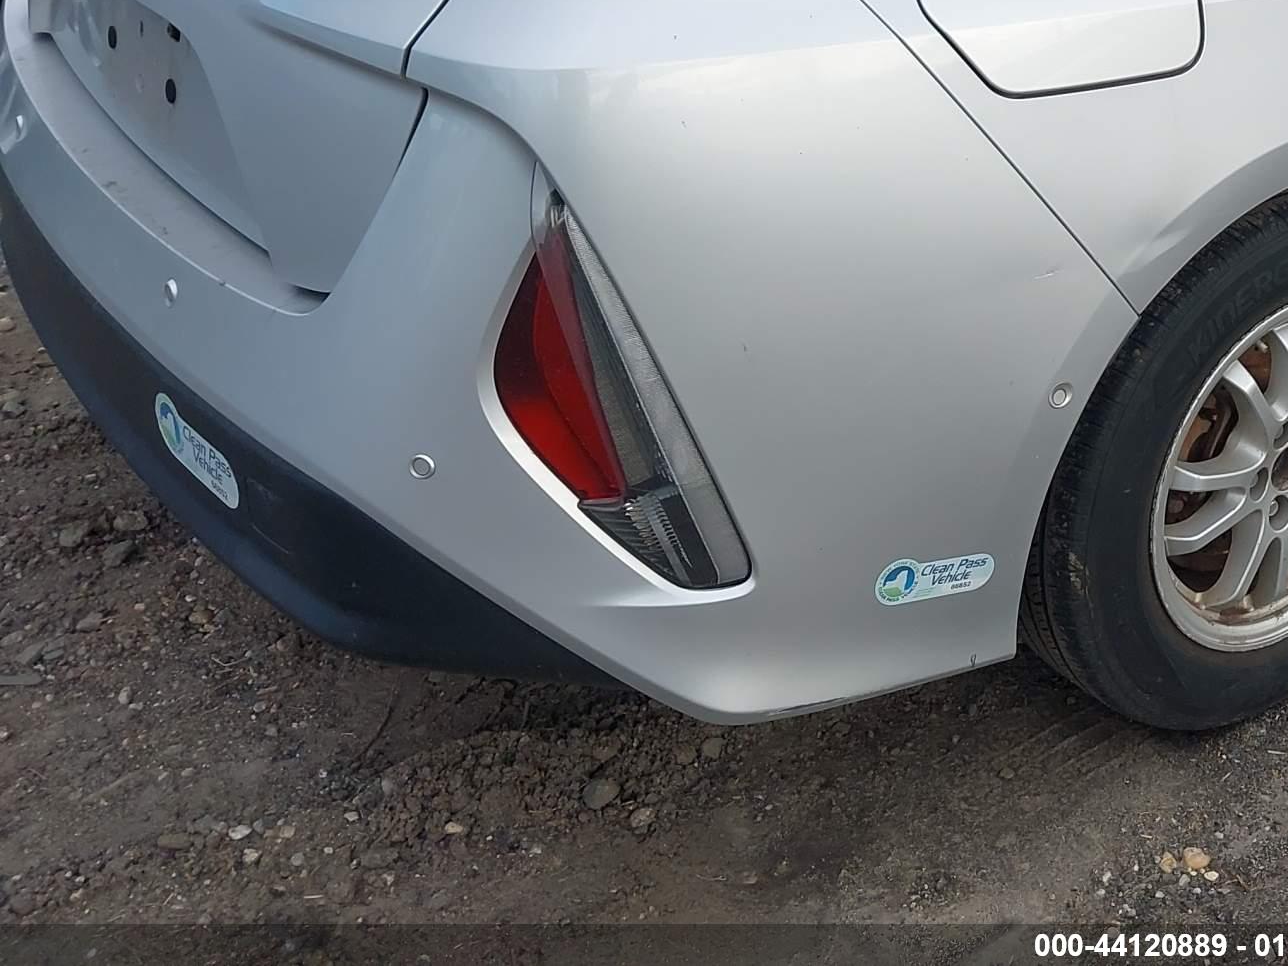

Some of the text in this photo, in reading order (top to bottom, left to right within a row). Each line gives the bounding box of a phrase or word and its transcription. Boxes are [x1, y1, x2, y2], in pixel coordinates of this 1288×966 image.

[920, 557, 988, 577] Clean Pass
[931, 570, 972, 586] Vehicle
